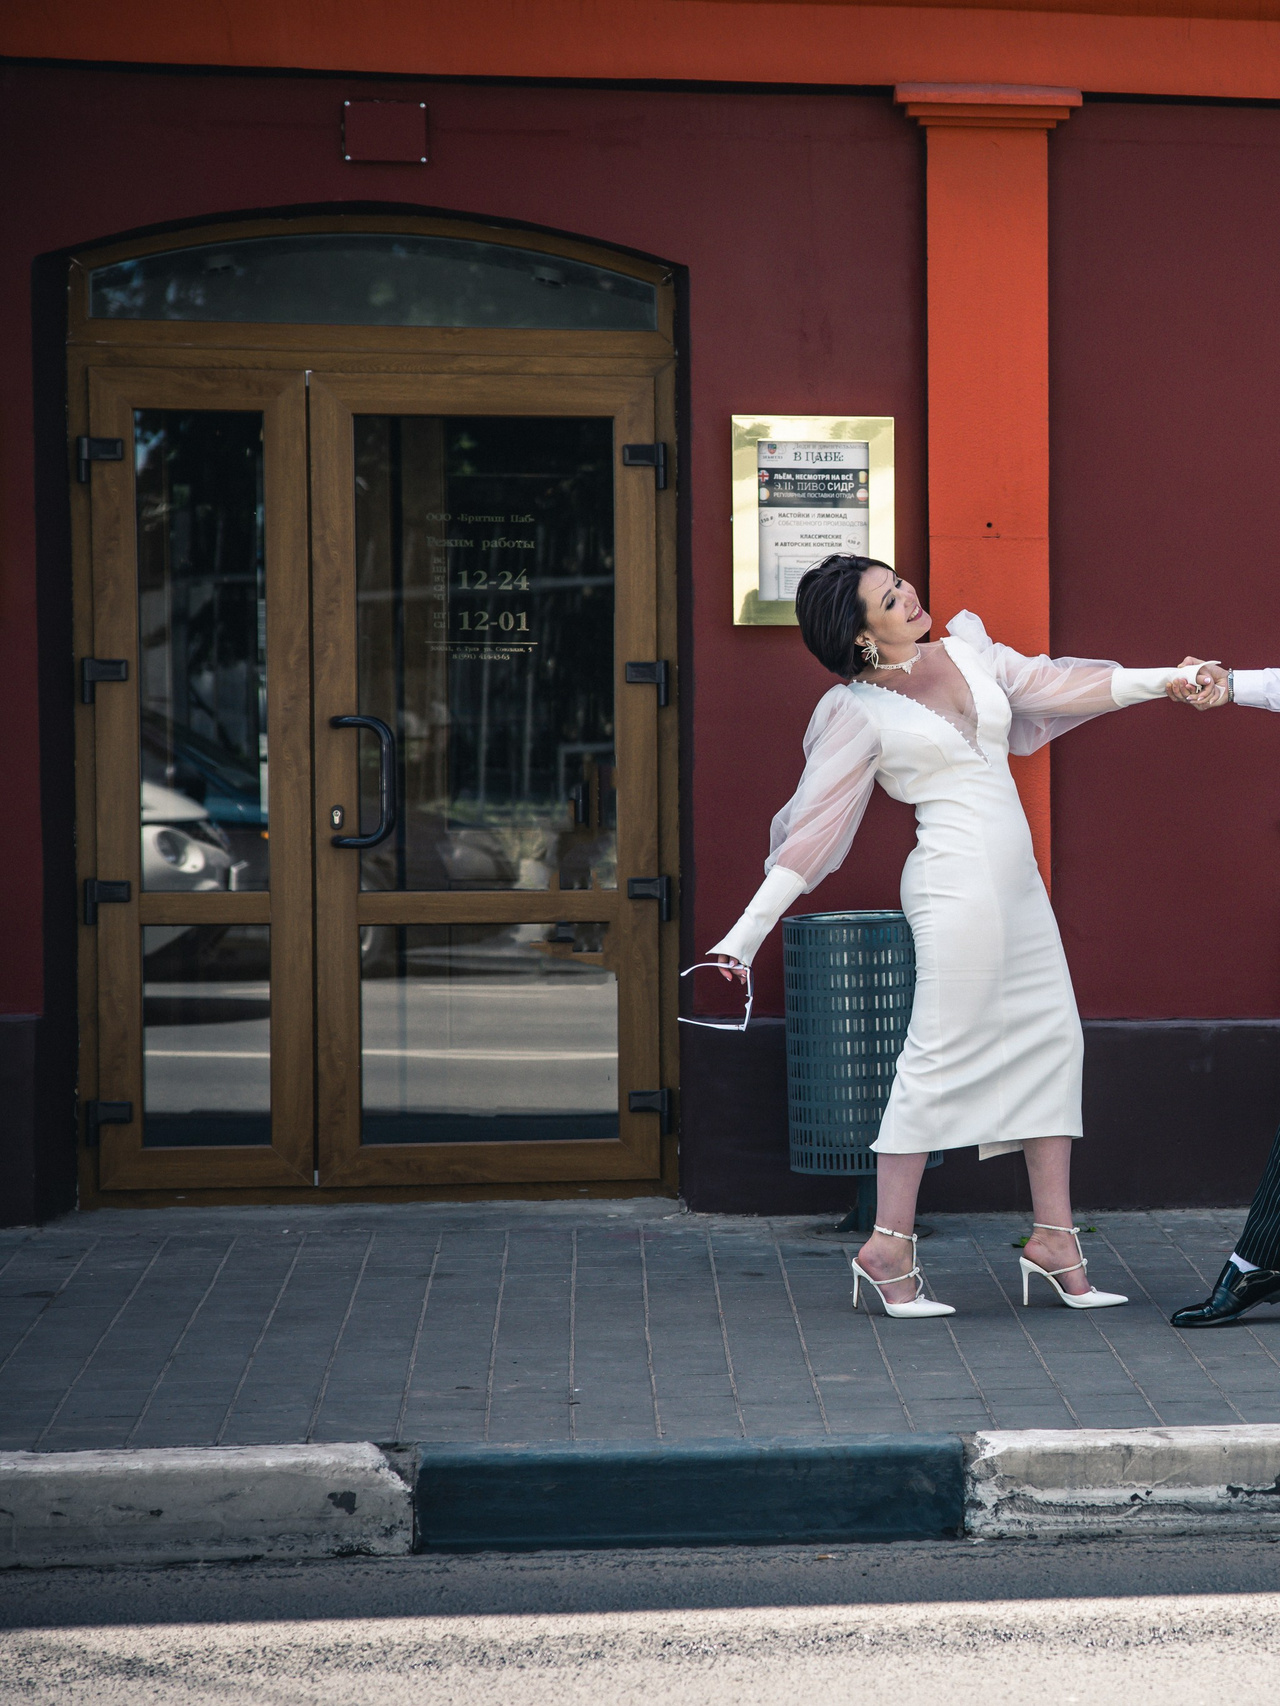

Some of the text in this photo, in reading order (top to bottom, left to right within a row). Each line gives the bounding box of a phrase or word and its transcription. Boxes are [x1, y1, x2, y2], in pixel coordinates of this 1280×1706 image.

[793, 451, 802, 462] В
[805, 451, 844, 464] ПАБЕ:
[795, 473, 831, 481] НЕСМОТРЯ
[831, 473, 841, 481] НА
[841, 472, 854, 481] ВСЁ
[773, 482, 794, 491] ЭЛЬ
[797, 482, 826, 491] ПИВО
[827, 482, 855, 492] СИДР
[835, 492, 855, 500] ОТТУДА
[426, 512, 452, 522] ООО
[823, 520, 867, 528] ПРОИЗВОДСТВА
[426, 536, 535, 551] Режим работы
[457, 568, 530, 591] 12-24
[458, 610, 530, 632] 12-01
